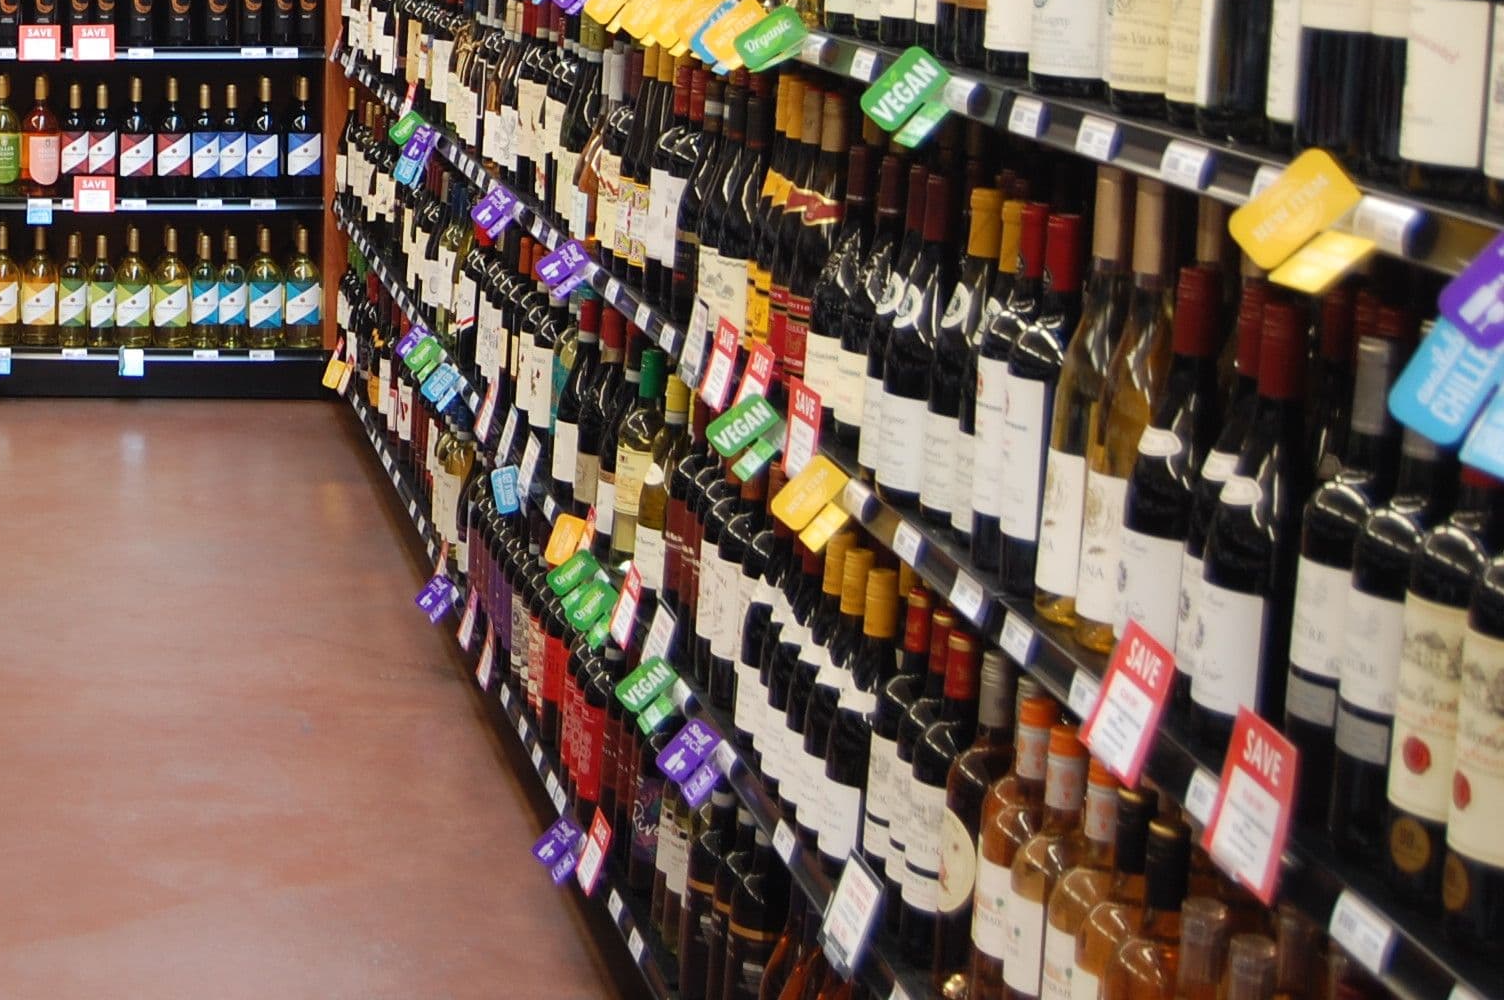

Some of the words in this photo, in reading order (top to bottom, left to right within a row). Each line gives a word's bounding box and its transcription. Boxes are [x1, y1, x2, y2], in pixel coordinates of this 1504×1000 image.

[28, 29, 53, 37] SAVE
[81, 28, 107, 37] SAVE
[744, 17, 793, 54] Organic
[871, 57, 939, 123] VEGAN
[82, 180, 107, 189] SAVE
[560, 251, 576, 269] PICK
[720, 327, 735, 353] SAVE
[752, 351, 769, 378] SAVE
[795, 389, 816, 420] SAVE
[714, 402, 773, 450] VEGAN
[555, 559, 586, 585] Organic
[575, 591, 605, 621] Organic
[1125, 635, 1163, 691] SAVE
[623, 662, 671, 706] VEGAN
[680, 734, 705, 755] PICK
[688, 724, 713, 746] Staff
[1241, 727, 1285, 788] SAVE
